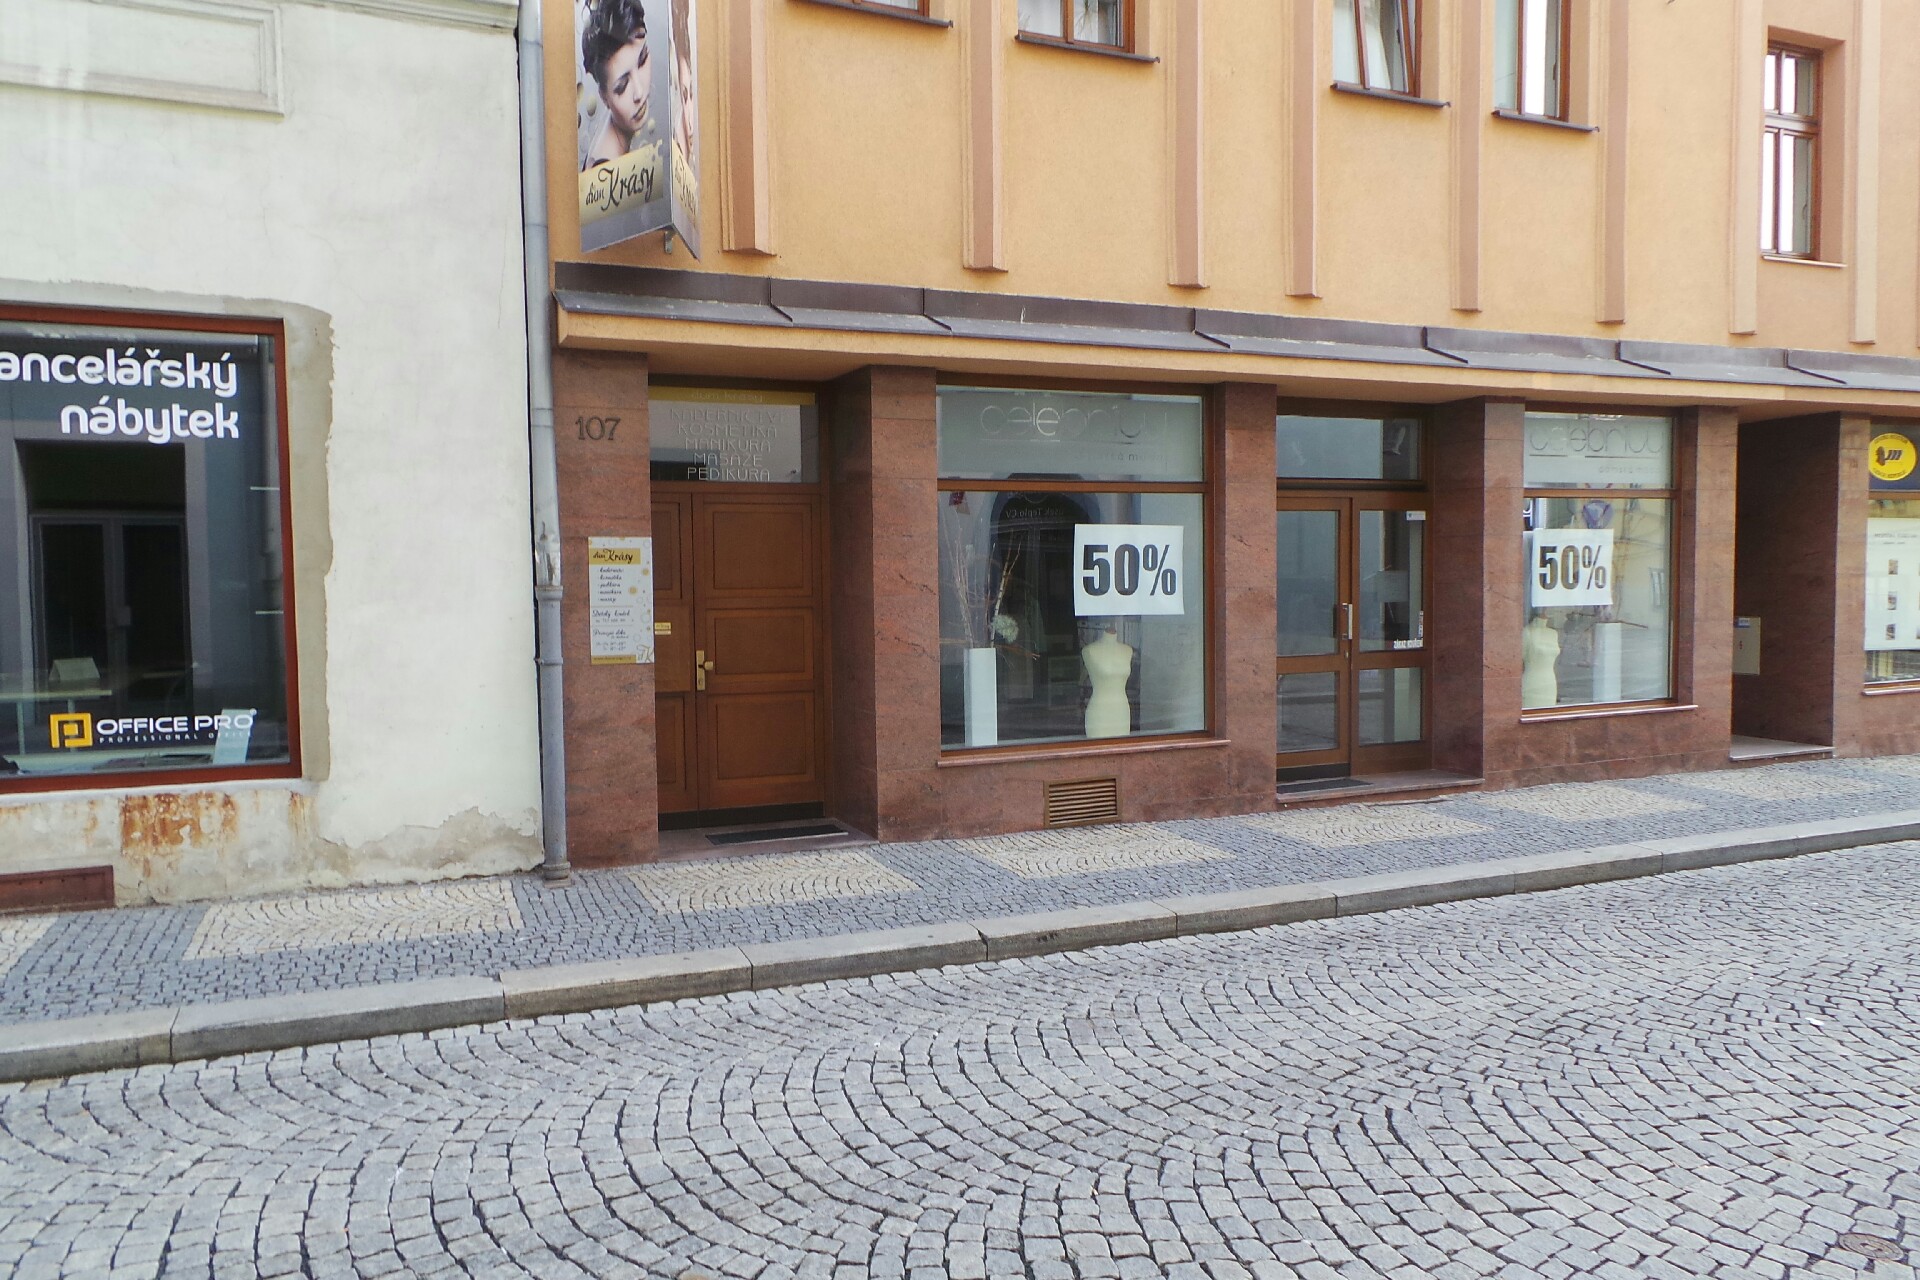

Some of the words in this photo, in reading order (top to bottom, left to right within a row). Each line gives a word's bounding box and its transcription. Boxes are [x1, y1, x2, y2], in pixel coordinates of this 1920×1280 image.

[598, 164, 655, 212] Krásy
[0, 347, 237, 397] ancelářský
[61, 395, 239, 444] nábytek
[575, 415, 621, 440] 107
[1083, 543, 1176, 596] 50%
[1539, 545, 1606, 590] 50%
[97, 716, 188, 735] OFFICE
[195, 714, 253, 731] PRO
